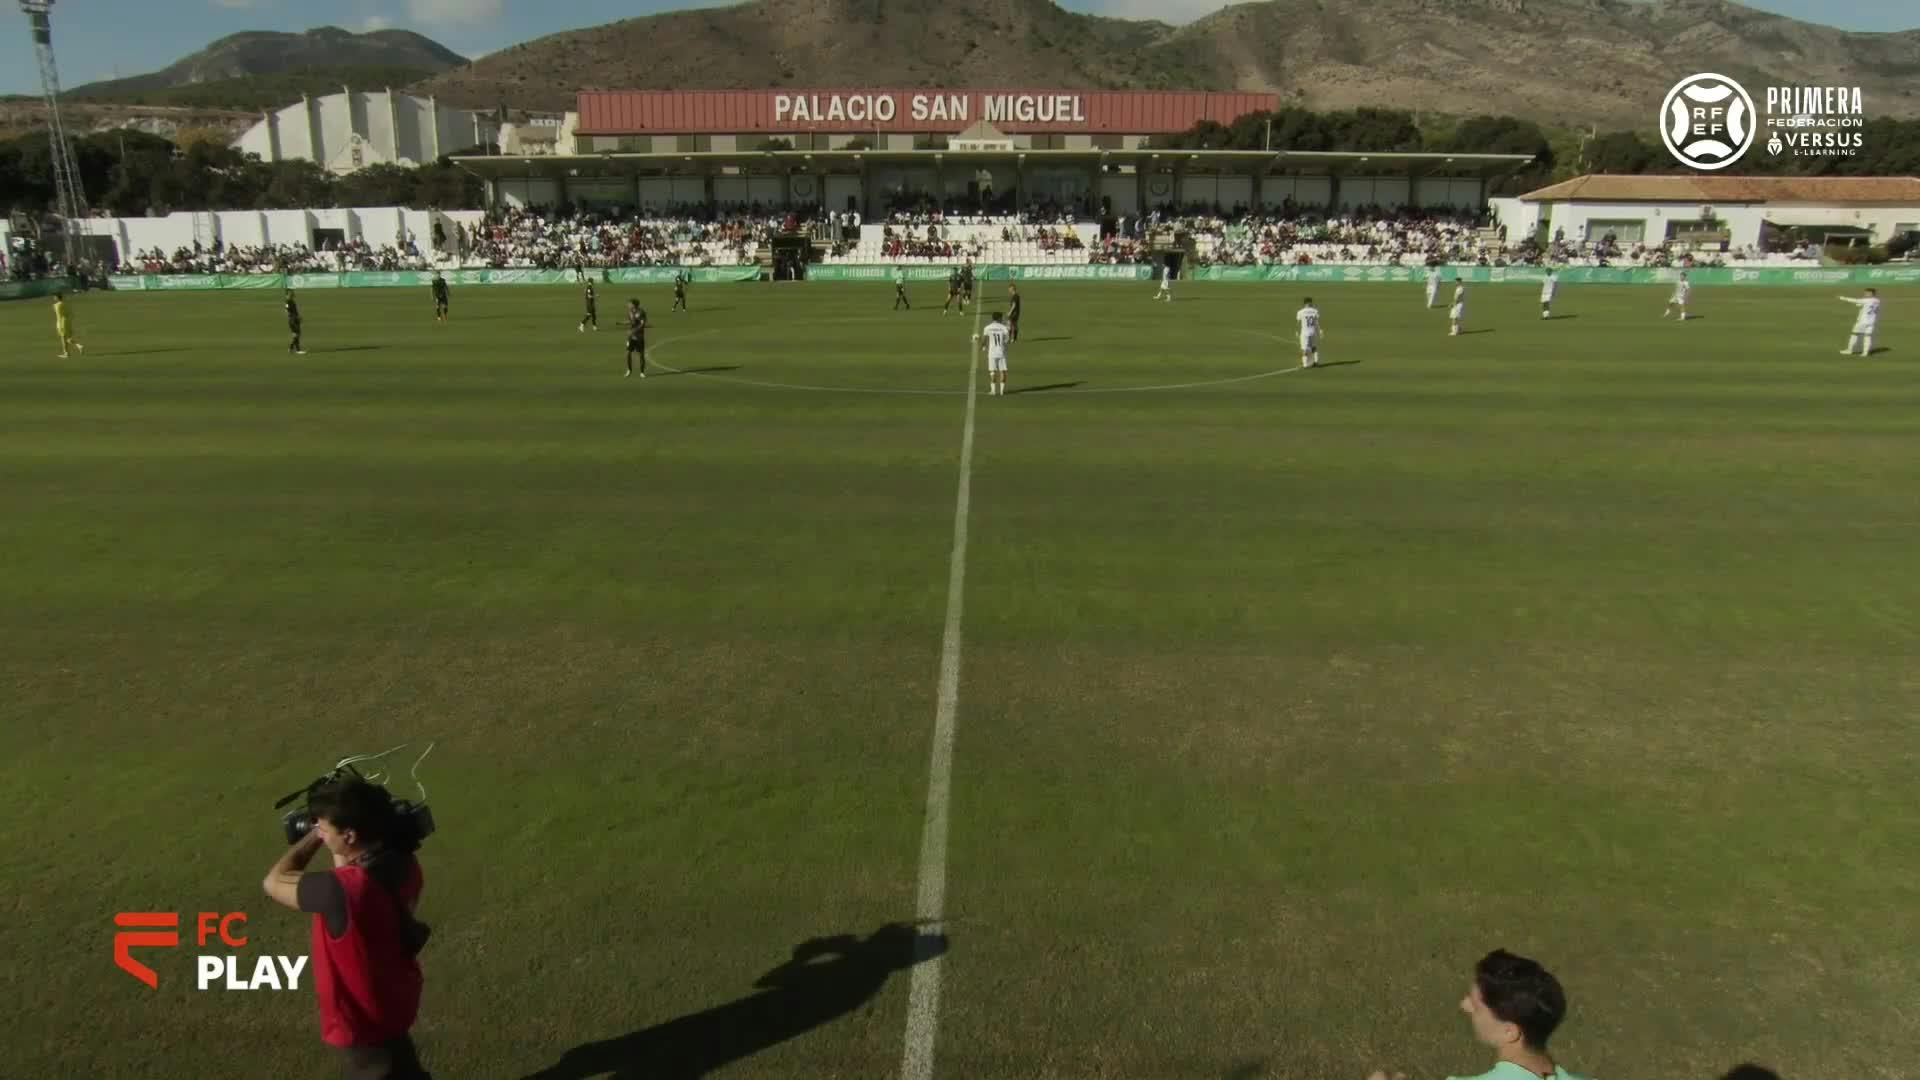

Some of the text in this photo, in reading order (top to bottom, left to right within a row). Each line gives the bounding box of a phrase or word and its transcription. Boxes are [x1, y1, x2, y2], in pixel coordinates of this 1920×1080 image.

[775, 95, 1085, 122] PALACIO SAN MIGUEL
[1023, 266, 1137, 278] BUSINESS CLUB
[993, 333, 1001, 346] 11
